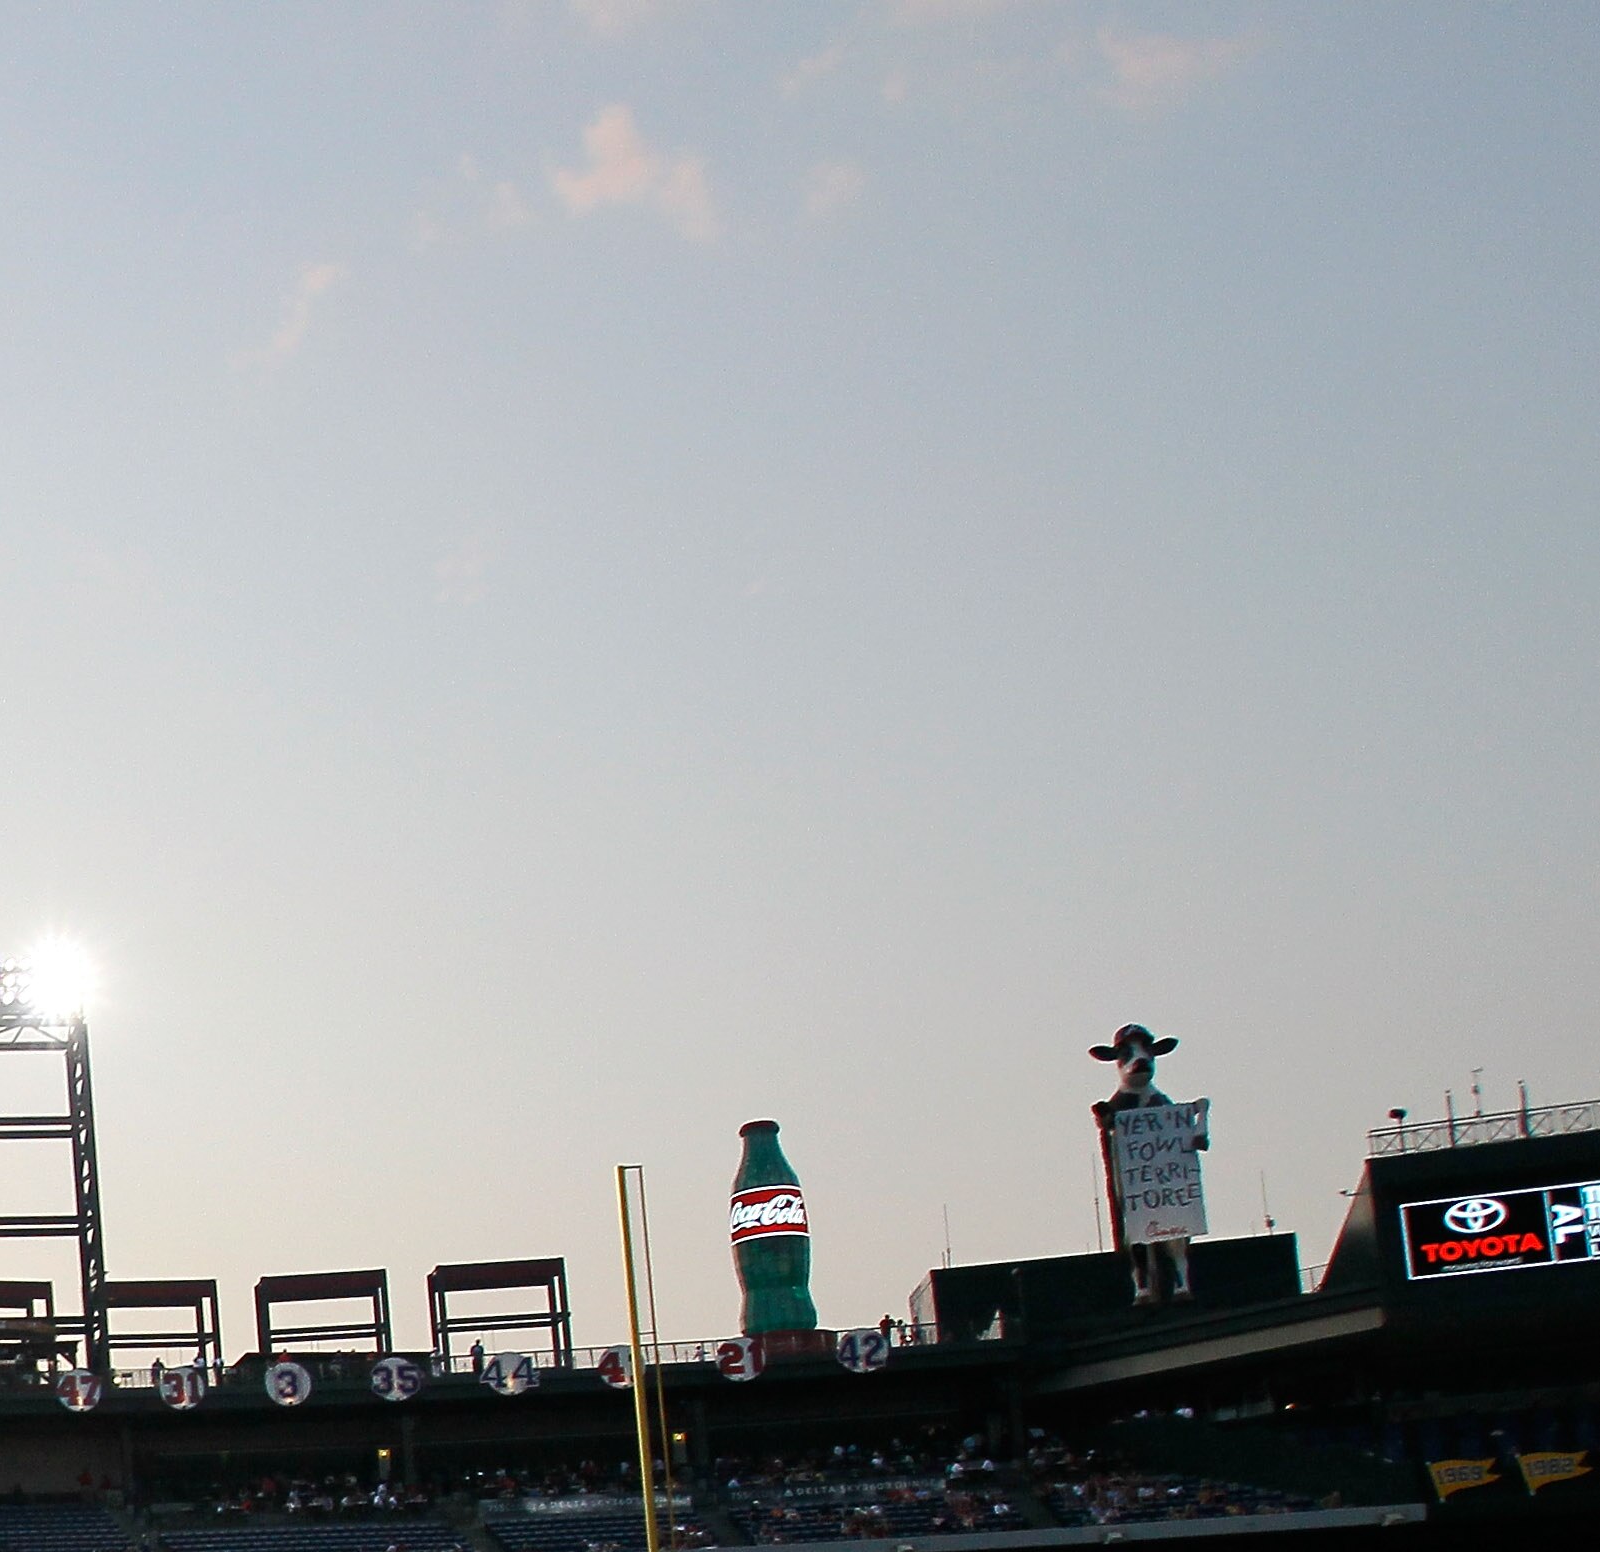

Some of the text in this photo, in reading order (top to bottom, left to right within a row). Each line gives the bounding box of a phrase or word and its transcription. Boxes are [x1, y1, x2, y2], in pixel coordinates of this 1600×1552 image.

[1119, 1111, 1163, 1136] YER
[1127, 1136, 1196, 1162] FOWL
[1126, 1183, 1201, 1211] TOREE
[730, 1193, 806, 1234] Coca-Cola
[1421, 1232, 1544, 1263] TOYOTA
[717, 1340, 766, 1376] 21
[838, 1333, 888, 1370] 42
[276, 1370, 299, 1399] 3
[372, 1364, 422, 1394] 35
[479, 1354, 541, 1390] 44
[56, 1374, 100, 1406] 47
[162, 1372, 201, 1405] 31
